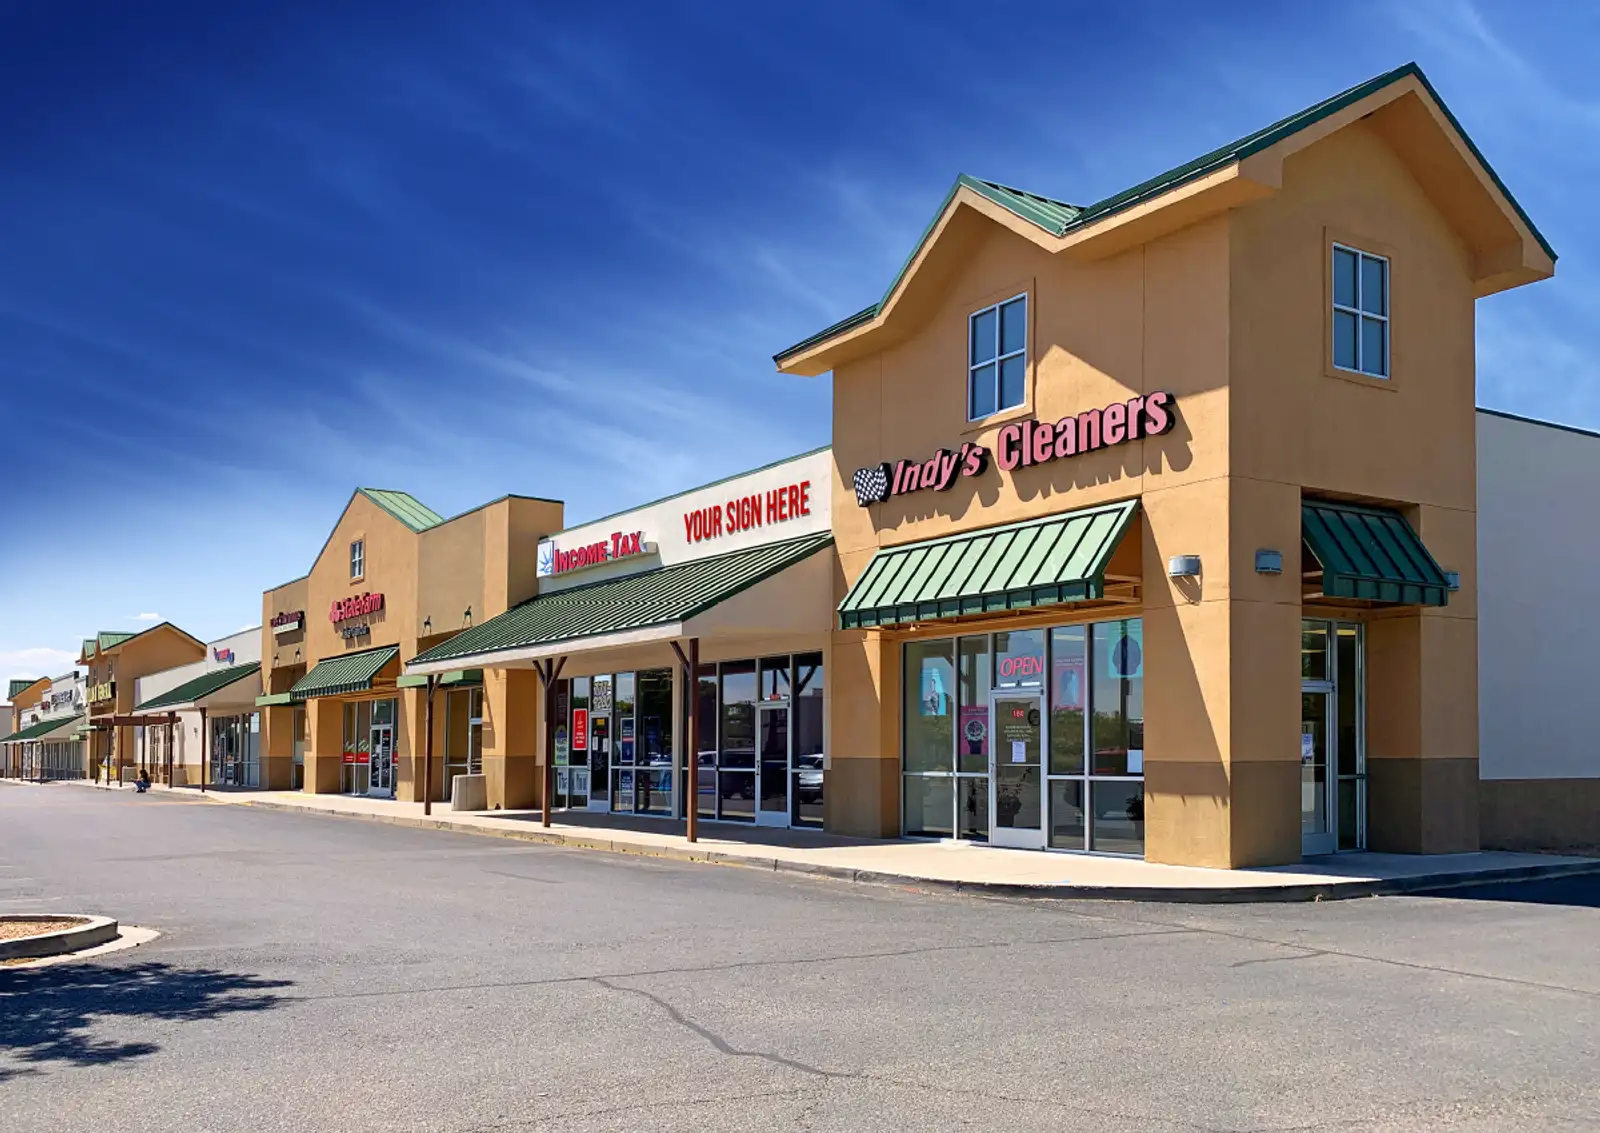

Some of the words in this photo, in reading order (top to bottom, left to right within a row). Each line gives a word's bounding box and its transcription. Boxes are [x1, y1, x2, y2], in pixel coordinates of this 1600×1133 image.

[891, 441, 988, 495] Indy's
[997, 390, 1174, 472] Cleaners
[683, 505, 722, 544] YOUR
[725, 493, 762, 535] SIGN
[766, 480, 811, 525] HERE
[1000, 656, 1044, 677] OPEN
